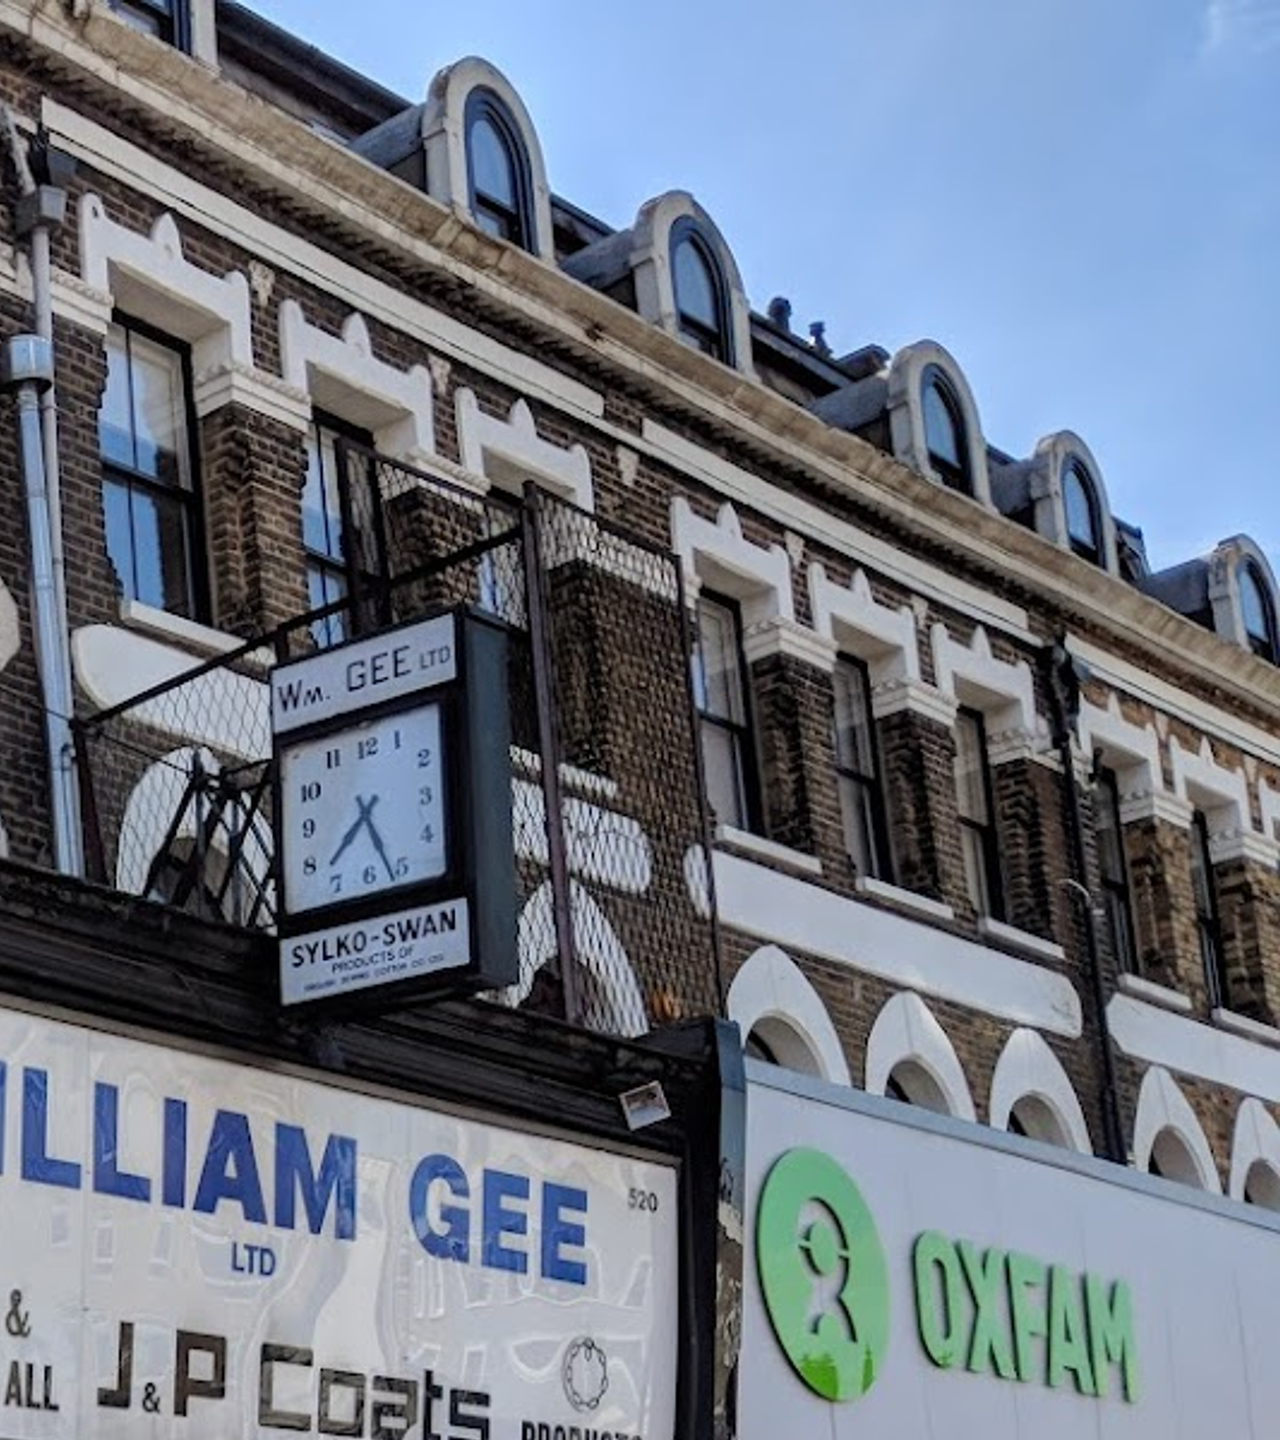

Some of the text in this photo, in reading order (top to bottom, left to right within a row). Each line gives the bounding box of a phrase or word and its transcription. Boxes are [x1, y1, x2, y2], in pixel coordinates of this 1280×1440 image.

[346, 645, 412, 692] GEE
[419, 645, 451, 671] LTD
[358, 737, 378, 759] 12
[394, 730, 401, 749] 1
[418, 749, 431, 768] 2
[301, 782, 321, 802] 10
[419, 787, 432, 805] 3
[302, 818, 315, 839] 9
[421, 825, 434, 843] 4
[303, 856, 317, 876] 8
[363, 866, 376, 884] 6
[395, 857, 409, 877] 5
[329, 874, 342, 893] 7
[291, 909, 457, 968] SYLKO-SWAN
[332, 944, 413, 974] PRODUCTS OF
[627, 1187, 658, 1213] 520
[407, 1153, 590, 1285] GEE
[230, 1241, 277, 1277] LTD
[4, 1288, 33, 1338] &
[910, 1230, 1140, 1402] OXFAM
[4, 1360, 60, 1412] ALL
